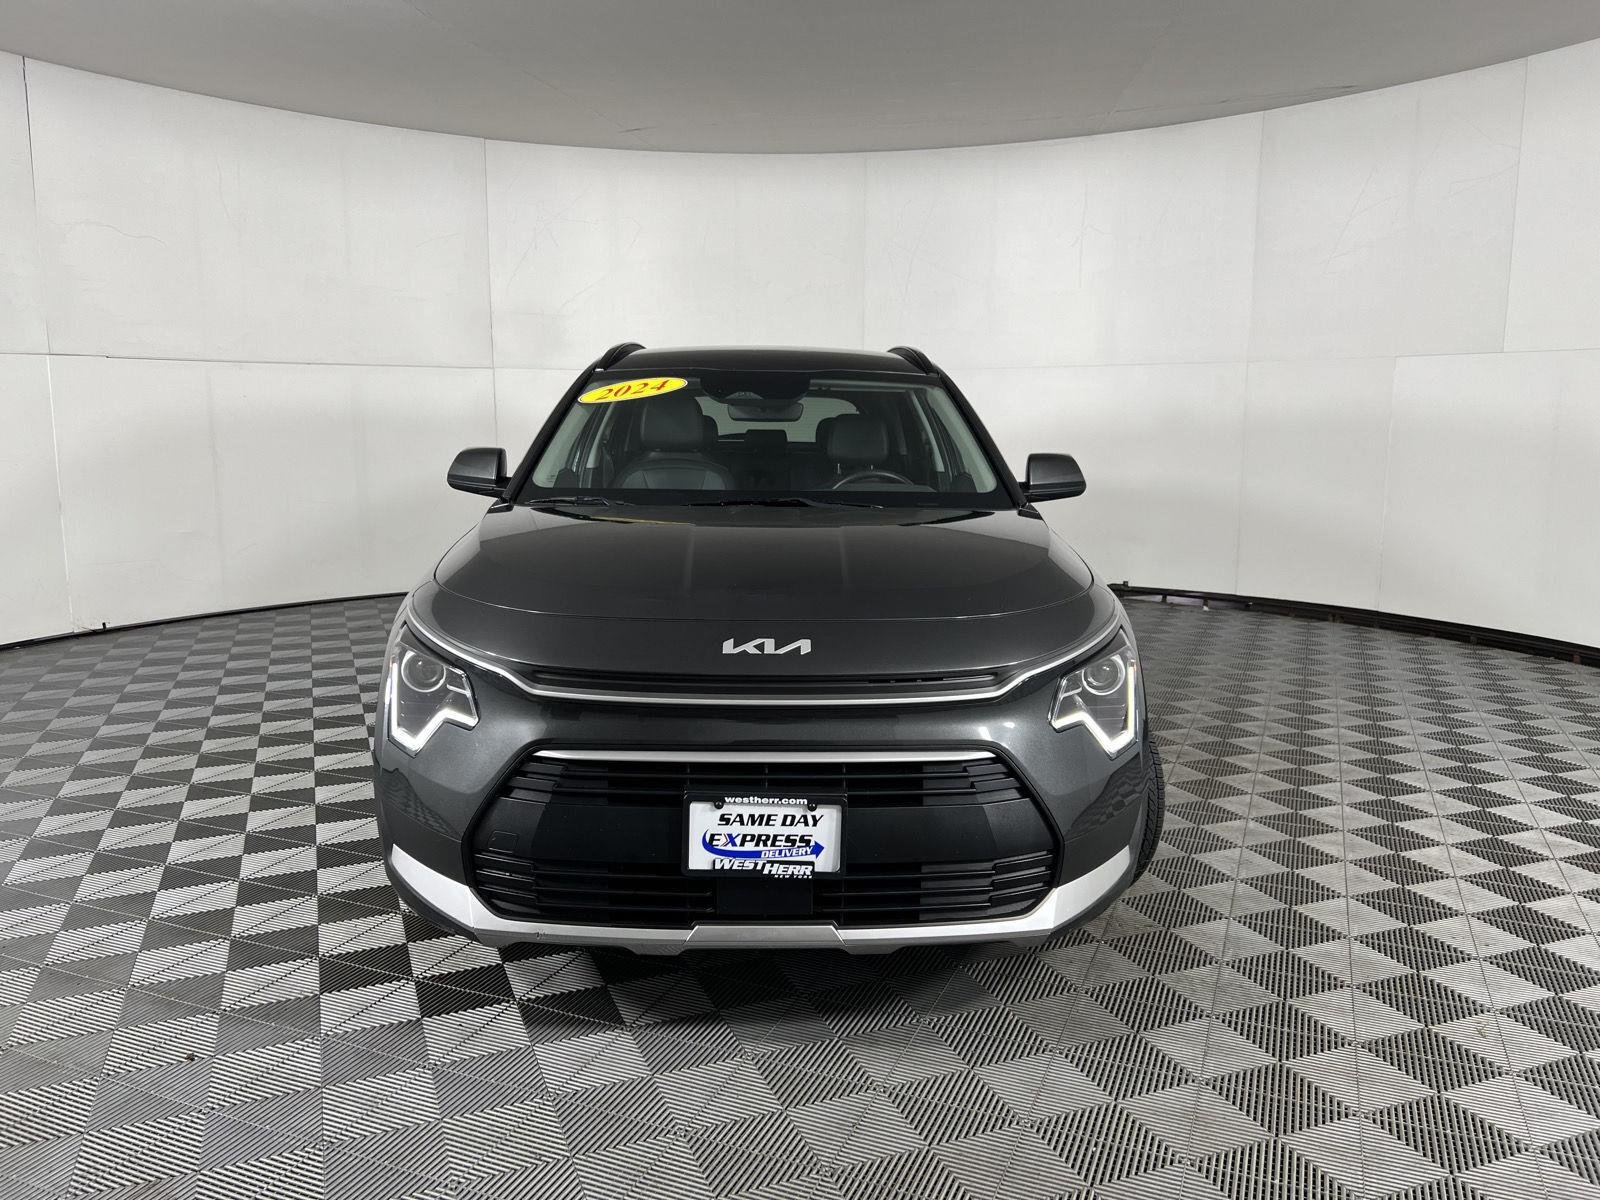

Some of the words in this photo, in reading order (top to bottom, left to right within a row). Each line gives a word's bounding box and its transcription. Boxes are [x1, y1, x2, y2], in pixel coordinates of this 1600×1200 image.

[594, 379, 671, 402] 2024
[722, 637, 812, 655] KIA
[724, 796, 808, 805] westherr.com
[717, 813, 778, 827] SAME
[781, 814, 824, 827] DAY
[708, 833, 813, 848] EXPRESS
[760, 848, 813, 859] DELIVERY
